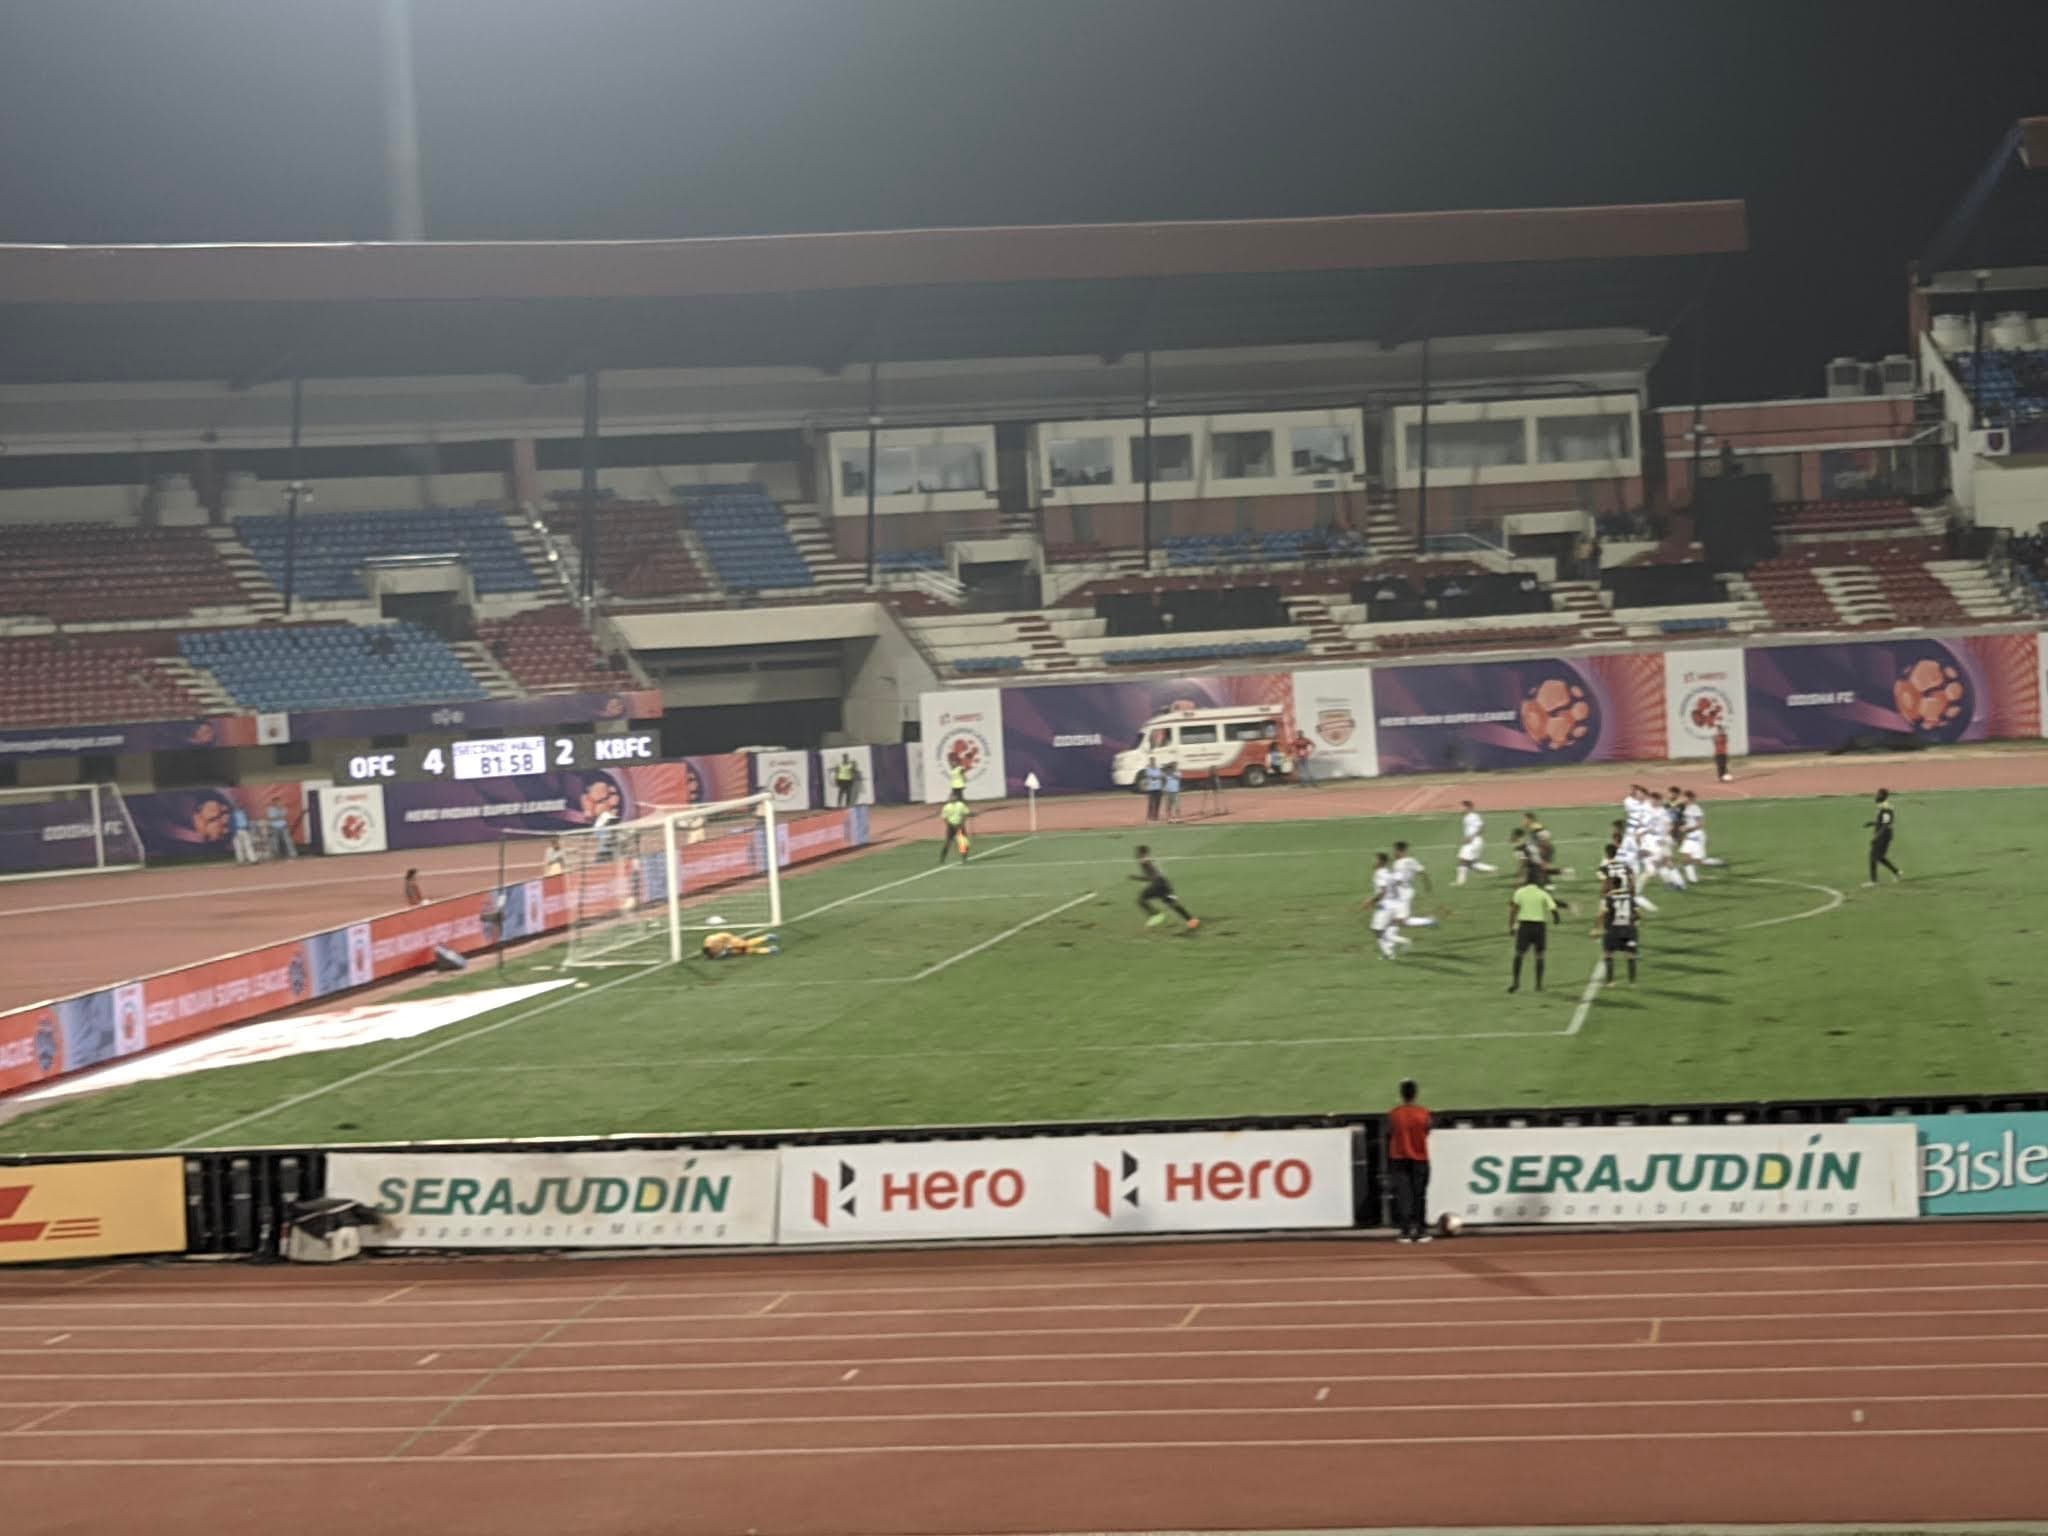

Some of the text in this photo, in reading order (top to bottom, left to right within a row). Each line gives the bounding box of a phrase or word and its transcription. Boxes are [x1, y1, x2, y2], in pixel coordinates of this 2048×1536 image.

[422, 748, 445, 775] 4
[555, 739, 575, 765] 2
[594, 736, 652, 761] KBFC
[349, 755, 396, 779] OFC
[1467, 1133, 1861, 1195] SERAJUDDÍN
[1919, 1129, 2048, 1198] Bisle
[374, 1158, 732, 1215] SERAJUDDÍN
[1465, 1200, 1860, 1218] Responsible Mining
[610, 1222, 727, 1239] Mining
